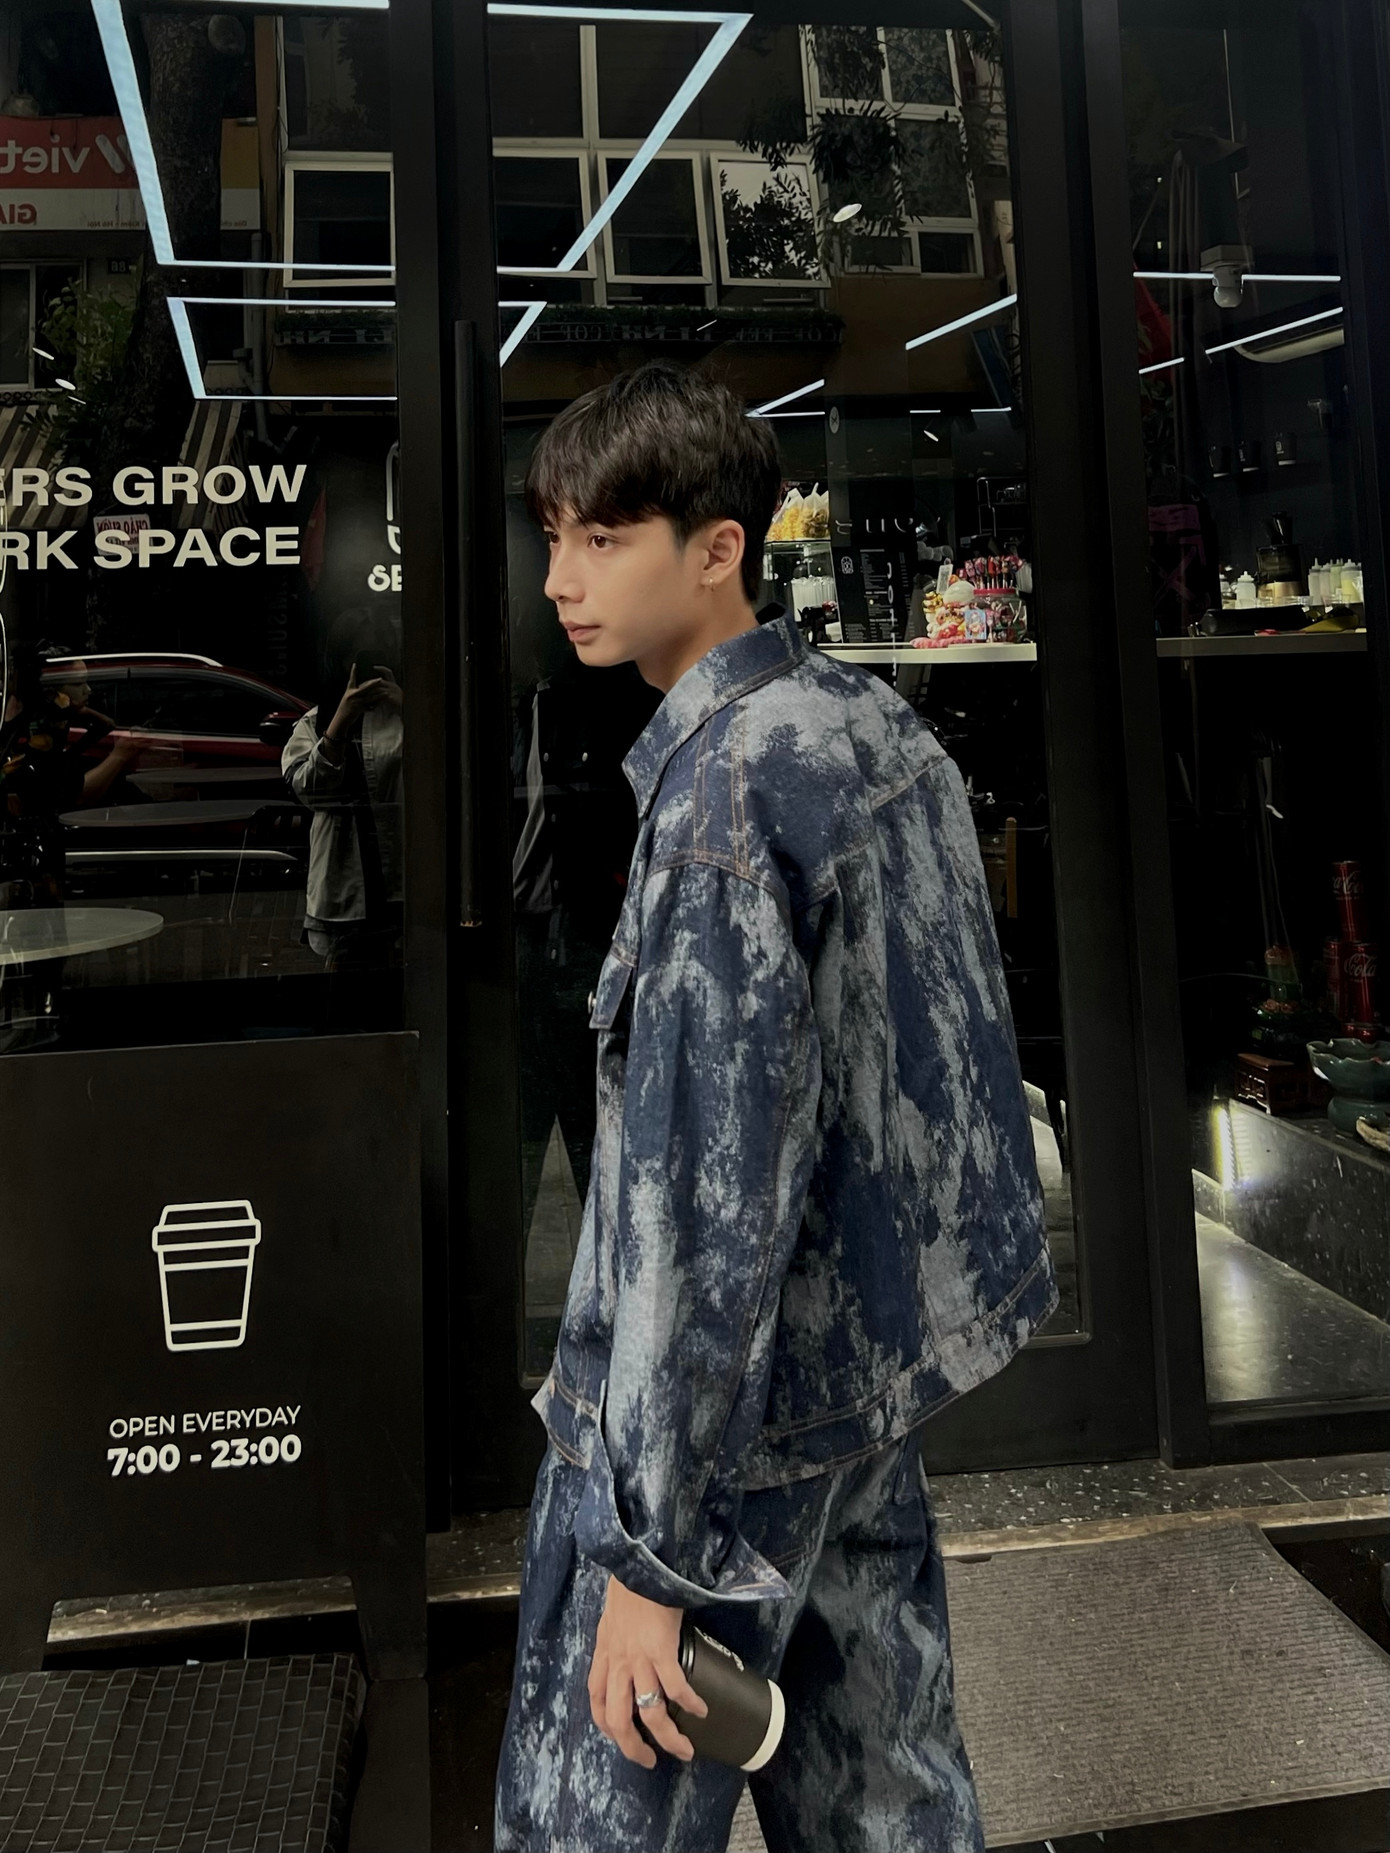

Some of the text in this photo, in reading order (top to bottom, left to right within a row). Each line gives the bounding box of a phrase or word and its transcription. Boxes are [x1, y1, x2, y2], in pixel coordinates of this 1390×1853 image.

[0, 464, 307, 507] RS GROW
[94, 526, 301, 569] SPACE
[109, 1405, 301, 1439] OPEN EVERYDAY
[107, 1434, 301, 1477] 7:00 - 23:00
